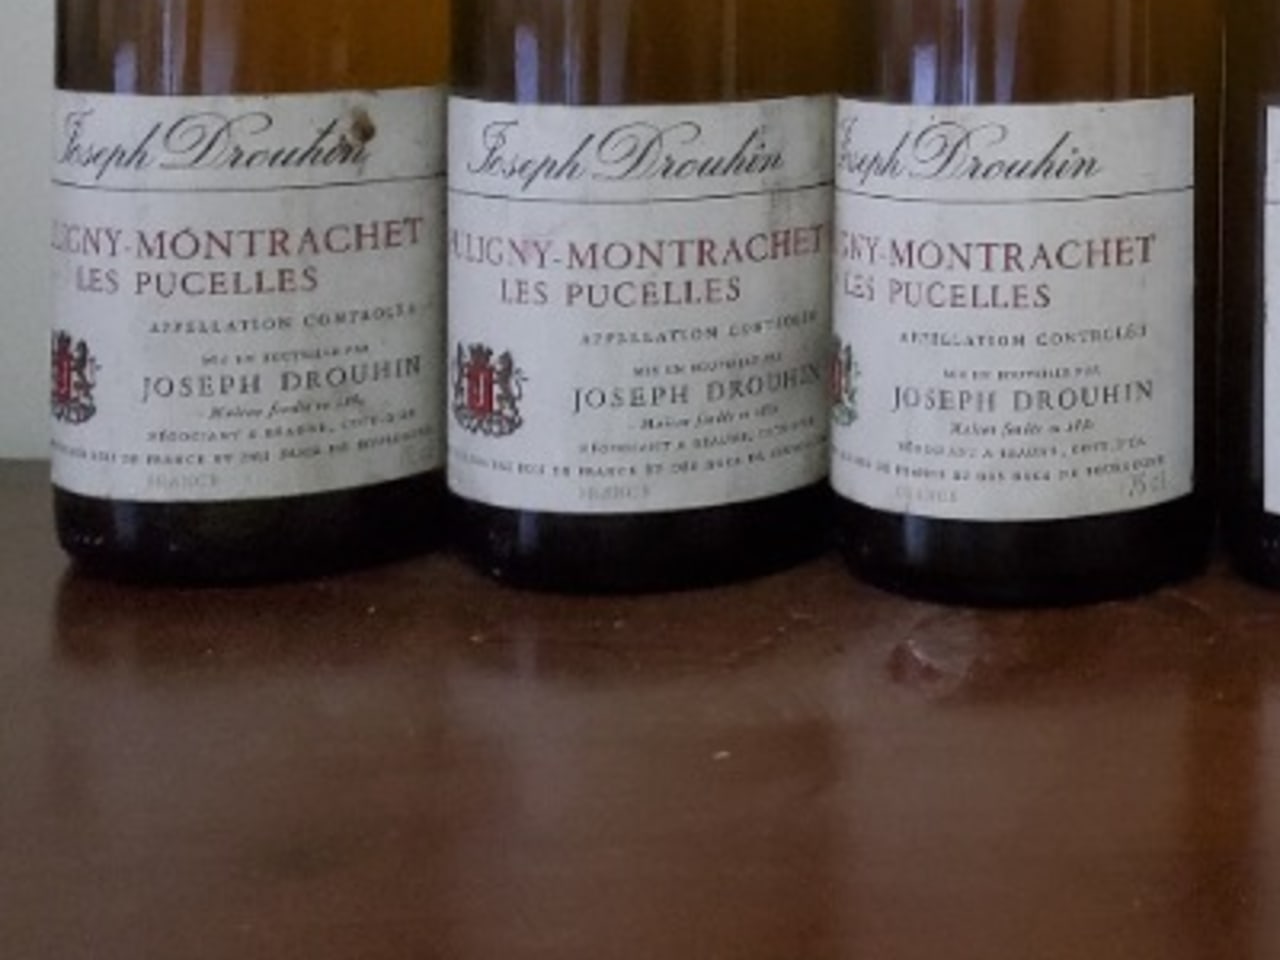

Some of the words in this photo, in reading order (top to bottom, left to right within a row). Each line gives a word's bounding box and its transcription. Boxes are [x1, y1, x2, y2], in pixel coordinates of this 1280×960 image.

[467, 120, 597, 192] Joseph
[591, 121, 785, 182] Drouhin
[908, 120, 1102, 182] Drouhin
[76, 265, 119, 295] LES
[134, 266, 319, 299] PUCELLES
[501, 277, 549, 305] LES
[565, 276, 742, 309] PUCELLES
[843, 272, 875, 302] LES
[889, 278, 1052, 310] PUCELLES
[142, 373, 261, 403] JOSEPH
[280, 354, 422, 391] DROUHIN
[891, 385, 997, 414] JOSEPH
[1013, 377, 1156, 413] DROUHIN
[572, 383, 690, 415] JOSEPH
